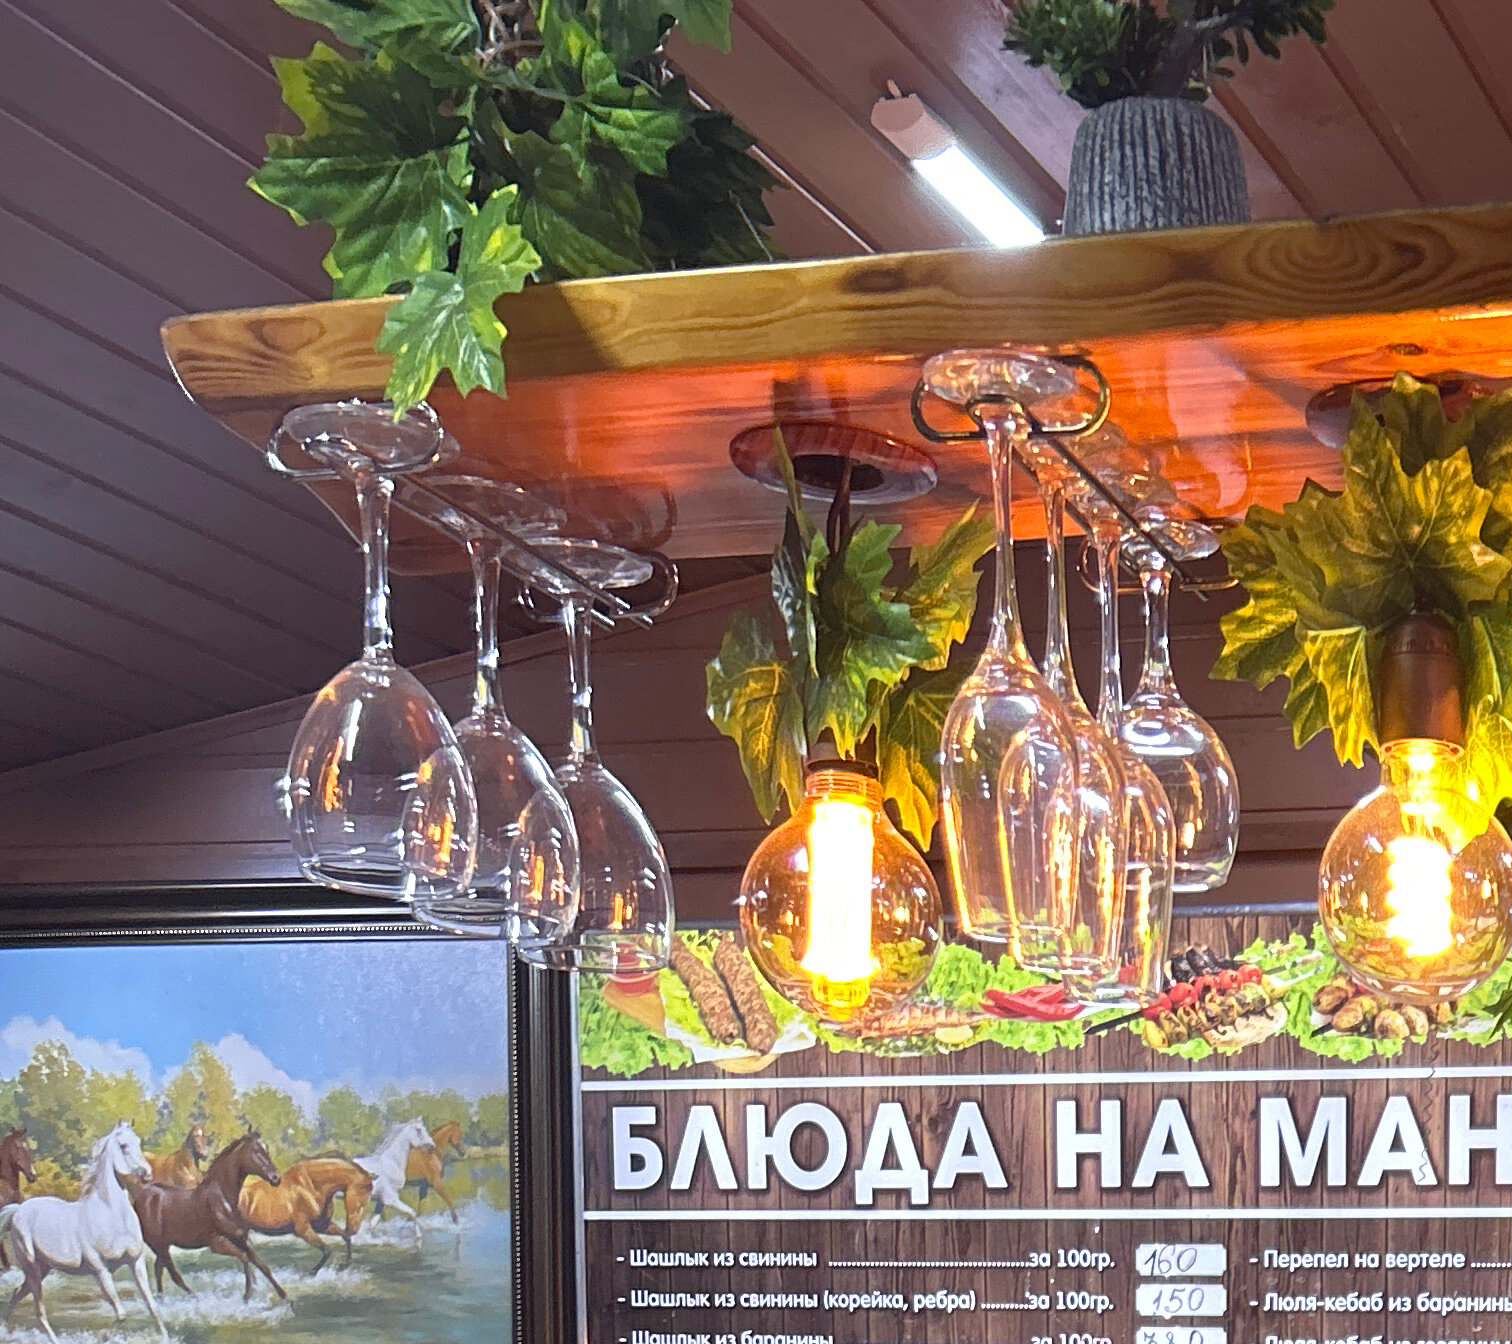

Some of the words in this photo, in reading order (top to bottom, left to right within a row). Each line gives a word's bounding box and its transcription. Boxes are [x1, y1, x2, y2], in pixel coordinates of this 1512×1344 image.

[612, 1102, 1008, 1205] БЛЮДА
[1057, 1099, 1210, 1188] НА
[630, 1249, 708, 1266] Шашлык
[714, 1253, 734, 1266] из
[739, 1253, 816, 1266] свинины
[1030, 1253, 1050, 1267] за
[1058, 1249, 1114, 1271] 100гр.
[1144, 1244, 1197, 1276] 160
[1264, 1250, 1348, 1272] Перепел
[1355, 1254, 1379, 1267] на
[1386, 1253, 1465, 1272] вертеле
[631, 1290, 710, 1307] Шашлык
[715, 1294, 735, 1307] из
[740, 1293, 818, 1307] свинины
[824, 1290, 908, 1312] (корейка,
[914, 1290, 975, 1313] ребра)
[1029, 1295, 1049, 1309] за
[1057, 1291, 1113, 1313] 100гр.
[1152, 1287, 1204, 1315] 150
[1264, 1292, 1383, 1311] Люля-кебаб
[1389, 1296, 1411, 1311] из
